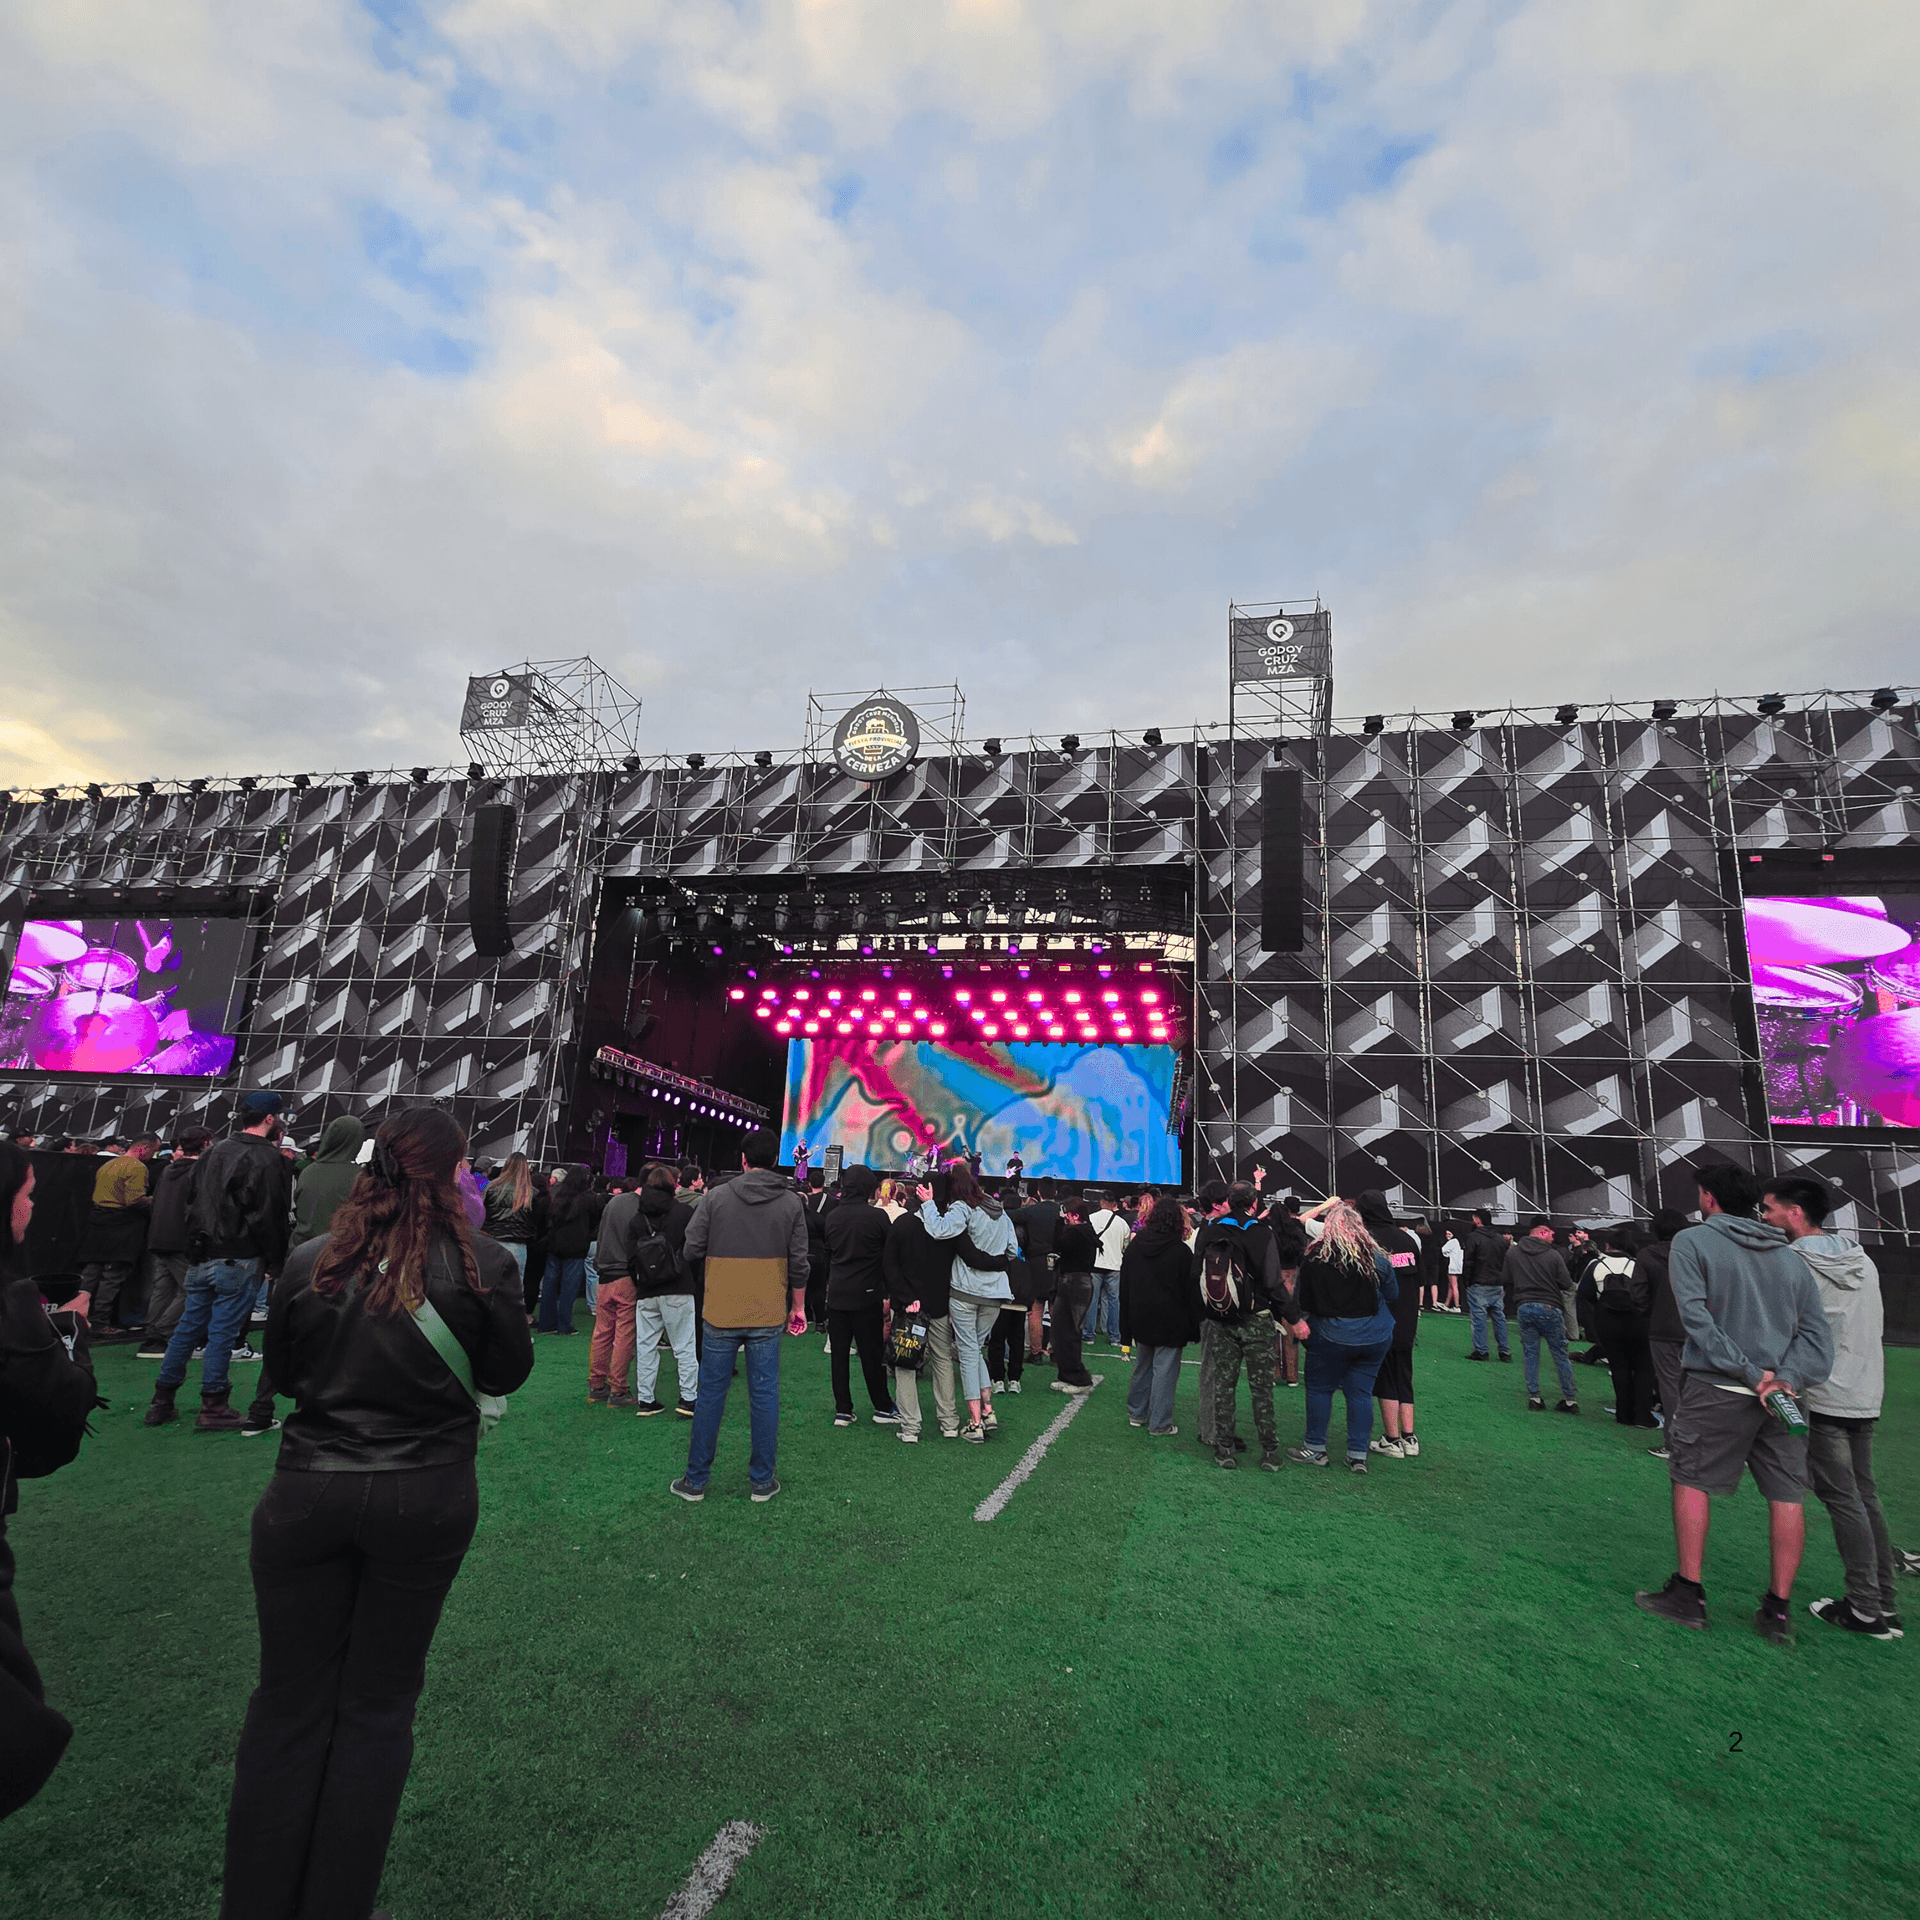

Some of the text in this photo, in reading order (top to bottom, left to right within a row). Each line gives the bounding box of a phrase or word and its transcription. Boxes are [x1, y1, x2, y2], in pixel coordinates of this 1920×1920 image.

[1257, 645, 1304, 656] GODOY
[1264, 654, 1298, 666] CRUZ
[1267, 664, 1296, 675] MZA
[480, 701, 513, 710] GODOY
[482, 709, 508, 717] CRUZ
[483, 717, 504, 726] MZA
[845, 756, 901, 773] CERVEZA
